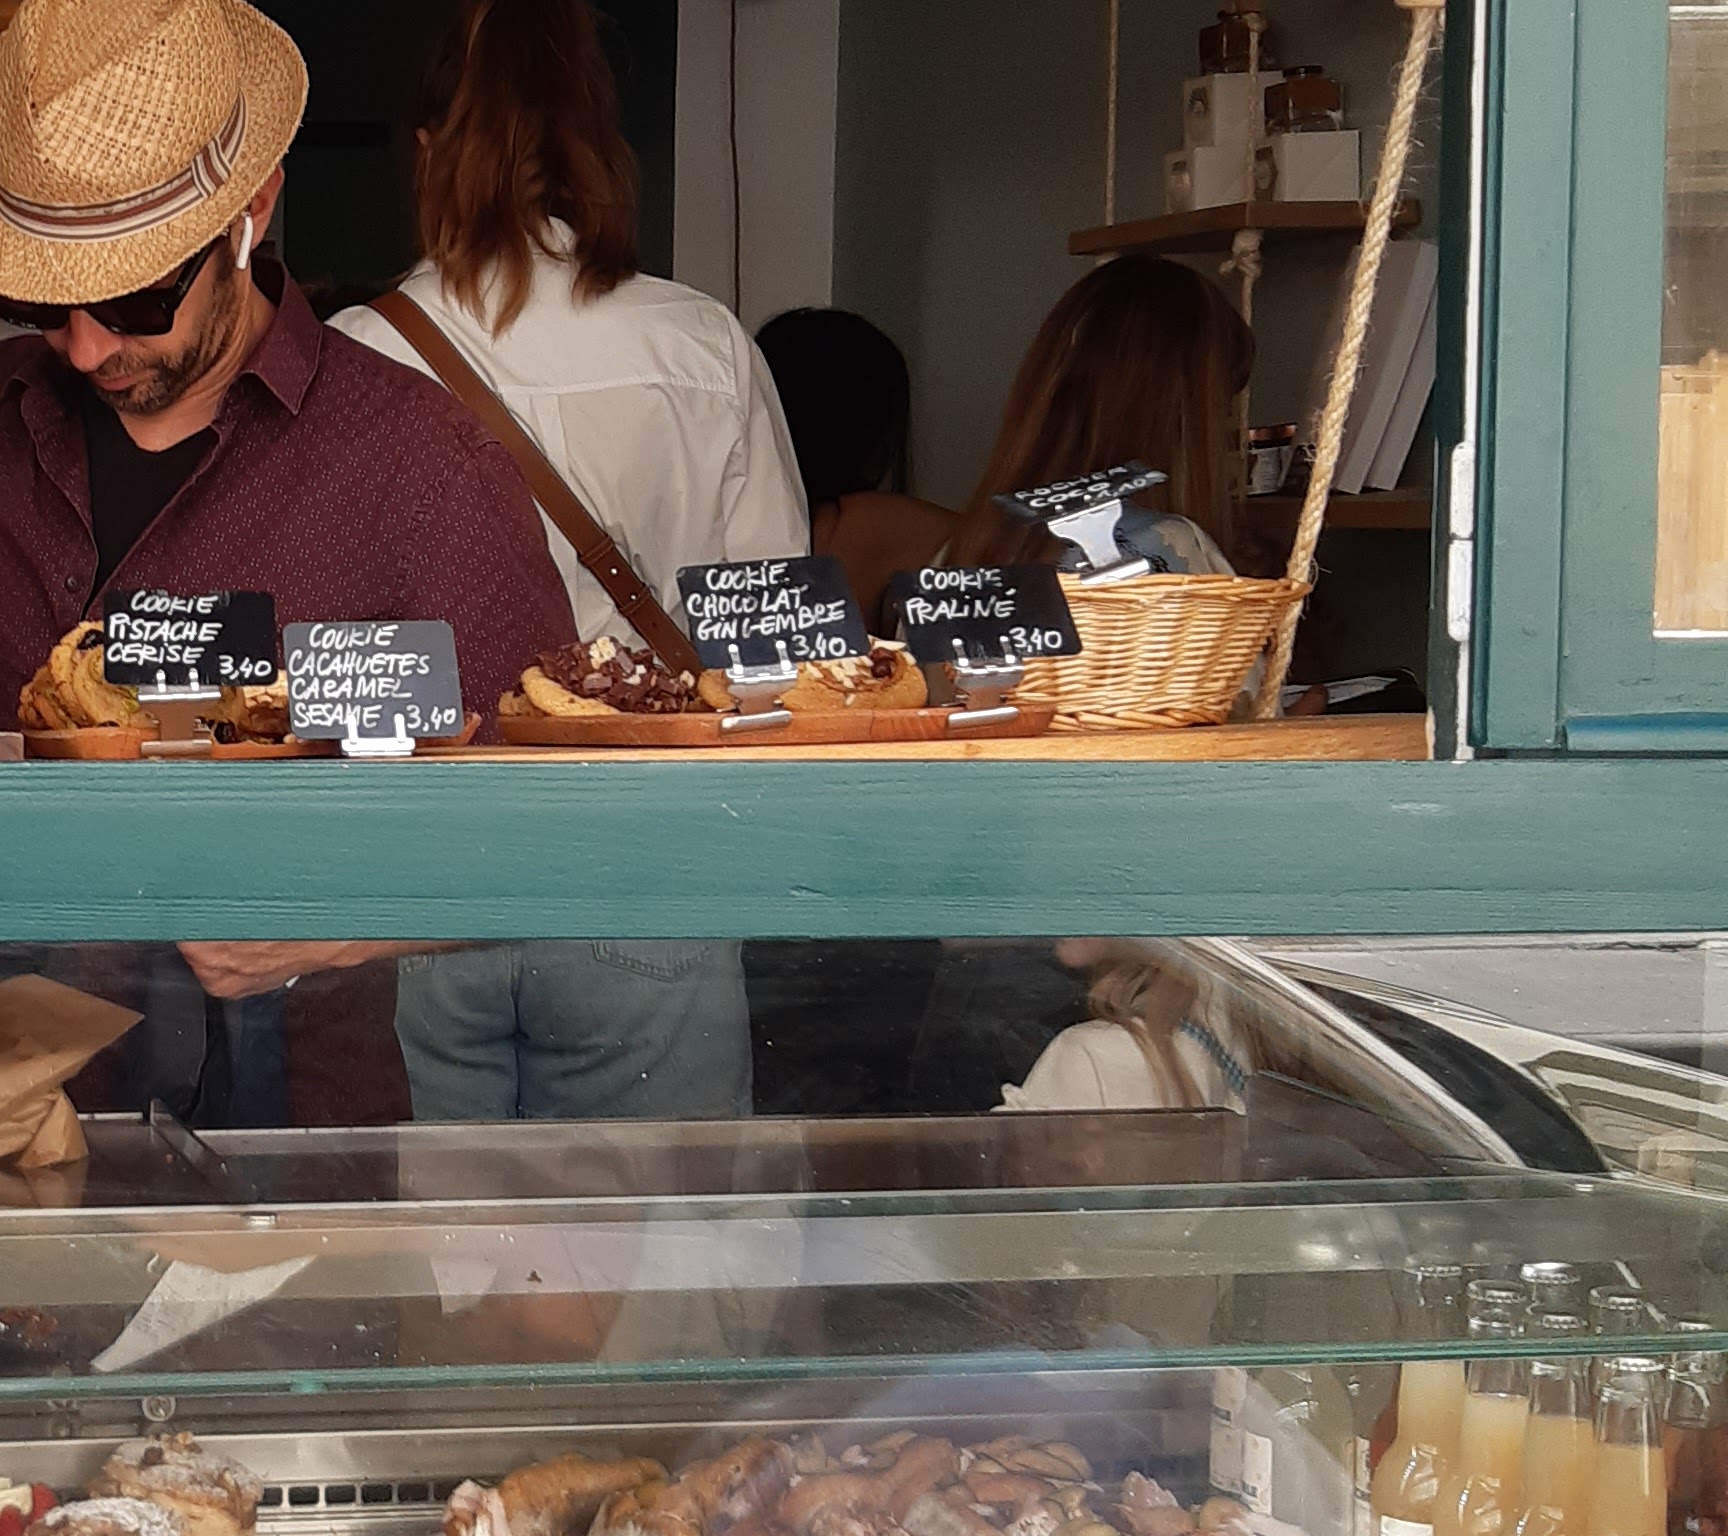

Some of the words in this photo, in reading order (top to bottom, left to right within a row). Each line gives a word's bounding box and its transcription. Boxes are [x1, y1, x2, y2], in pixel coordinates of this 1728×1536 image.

[1029, 481, 1112, 508] COCO
[705, 560, 789, 592] COOKIE
[919, 567, 1004, 592] COOKIE
[130, 590, 219, 615] COOKIE
[687, 585, 808, 618] CHOCOLAT
[108, 612, 223, 642] PISTACHE
[697, 598, 846, 641] GINGEMBRE
[308, 624, 399, 650] COOKIE
[1012, 627, 1063, 652] 3,40
[107, 643, 205, 665] CERISE
[218, 655, 272, 679] 3,40
[288, 650, 431, 677] CACAHUETES
[289, 676, 413, 701] CARAMEL
[293, 703, 382, 729] SESAME
[406, 705, 457, 730] 3,40
